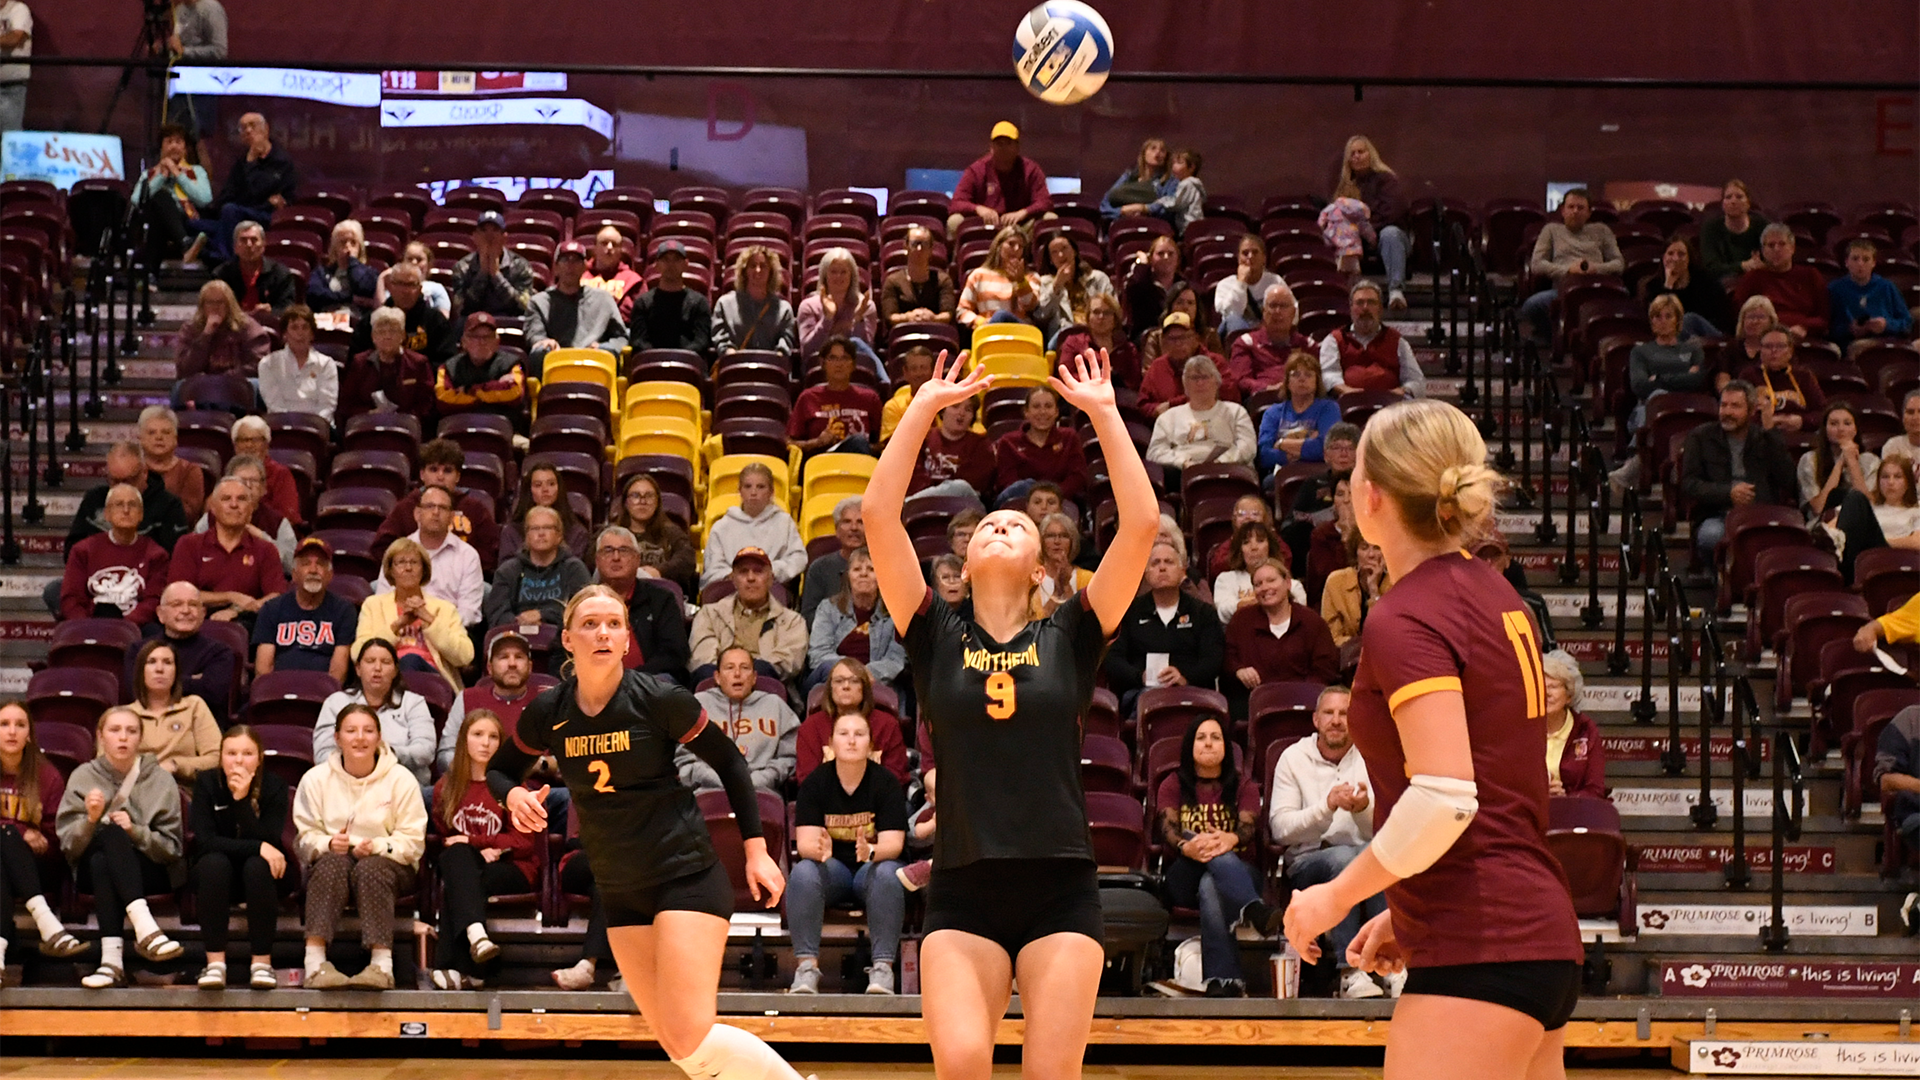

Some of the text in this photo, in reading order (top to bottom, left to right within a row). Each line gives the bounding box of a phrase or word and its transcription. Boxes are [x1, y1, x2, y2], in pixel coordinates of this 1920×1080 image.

[1022, 27, 1059, 74] molten
[276, 620, 335, 646] USA
[986, 671, 1016, 720] 9
[565, 730, 631, 758] NORTHERN
[587, 759, 617, 793] 2
[1614, 791, 1681, 805] PRIMROSE
[1753, 852, 1766, 864] is
[1821, 853, 1833, 867] C
[1670, 908, 1741, 923] PRIMROSE
[1791, 912, 1805, 925] is
[1810, 911, 1852, 932] living!
[1864, 914, 1874, 926] B
[1664, 967, 1676, 982] A
[1711, 965, 1785, 980] PRIMROSE
[1801, 966, 1831, 982] this
[1837, 967, 1851, 982] is
[1856, 966, 1901, 991] living!
[1742, 1045, 1818, 1061] PRIMROSE
[1836, 1047, 1866, 1063] this
[1873, 1048, 1887, 1063] is
